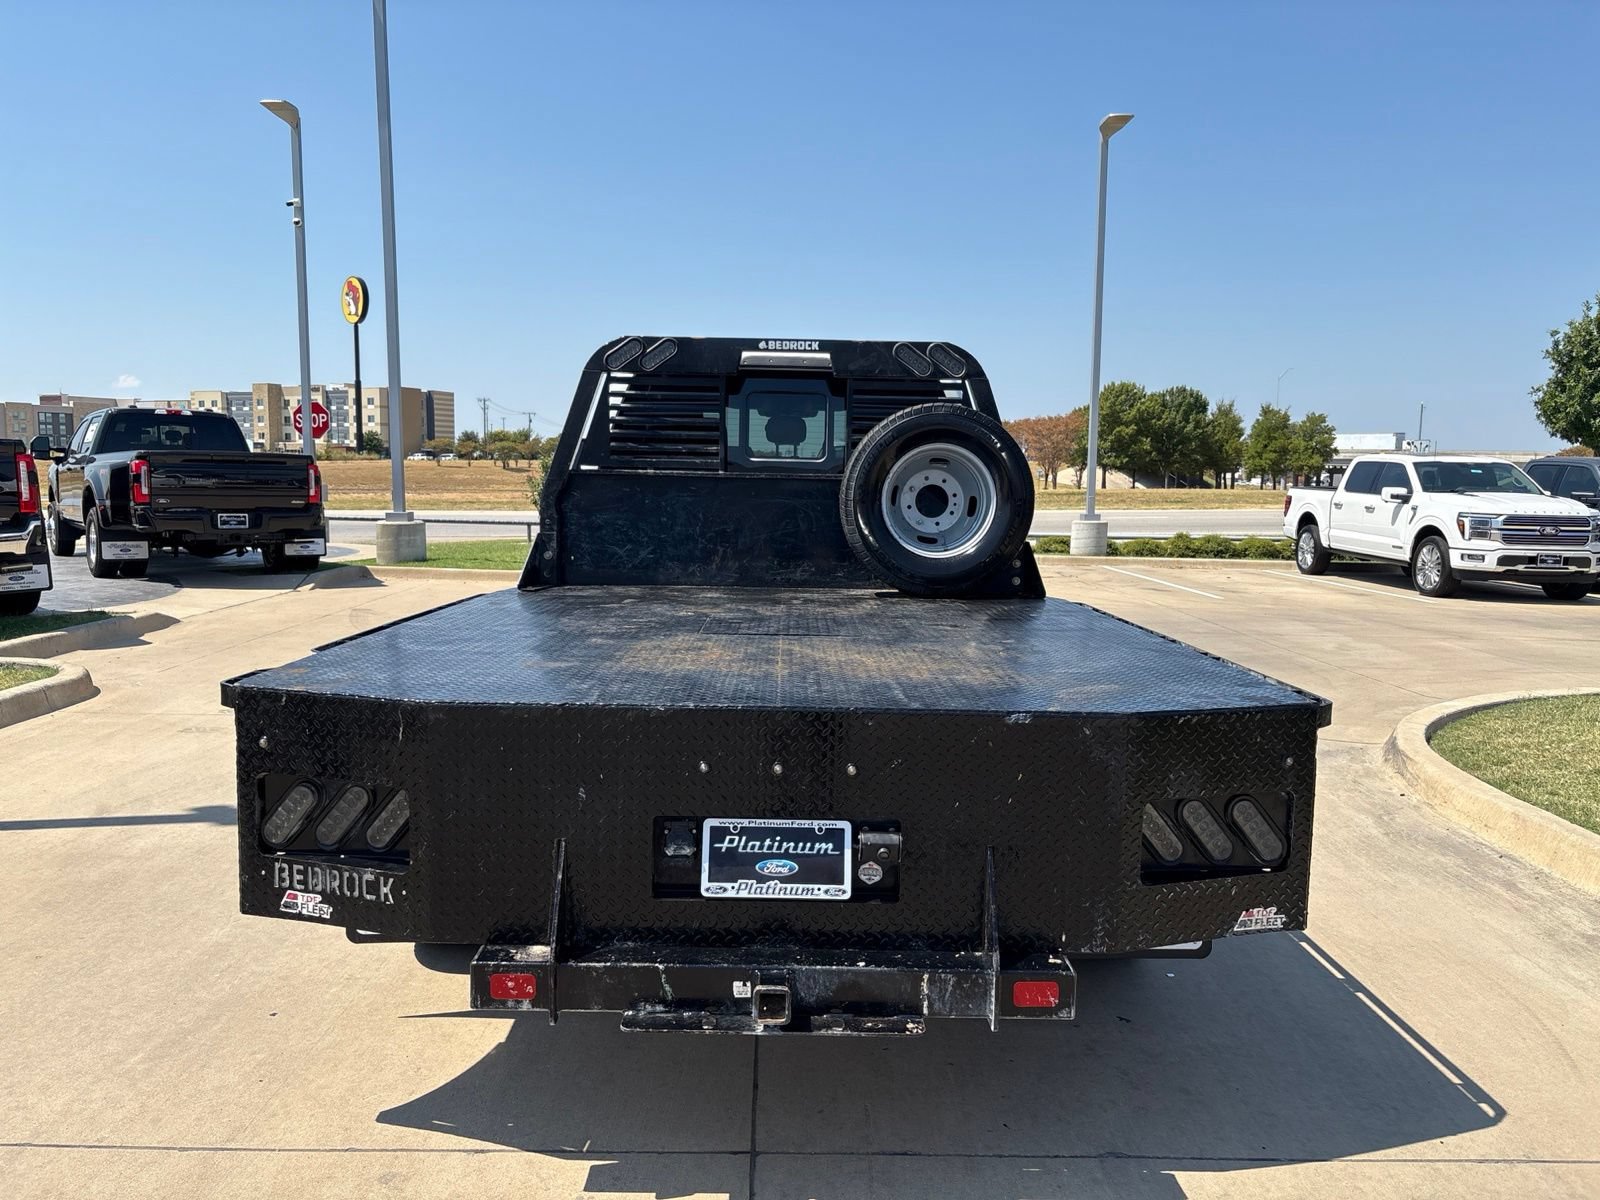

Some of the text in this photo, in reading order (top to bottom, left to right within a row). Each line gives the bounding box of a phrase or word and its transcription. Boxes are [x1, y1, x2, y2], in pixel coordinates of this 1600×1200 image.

[768, 340, 819, 351] BEDROCK
[296, 413, 327, 428] SOP
[718, 820, 838, 828] www.PlatinumFord.com
[713, 835, 841, 855] Platinum
[760, 860, 793, 875] Ford
[274, 861, 394, 905] BEDROCK
[736, 881, 819, 896] Platinum
